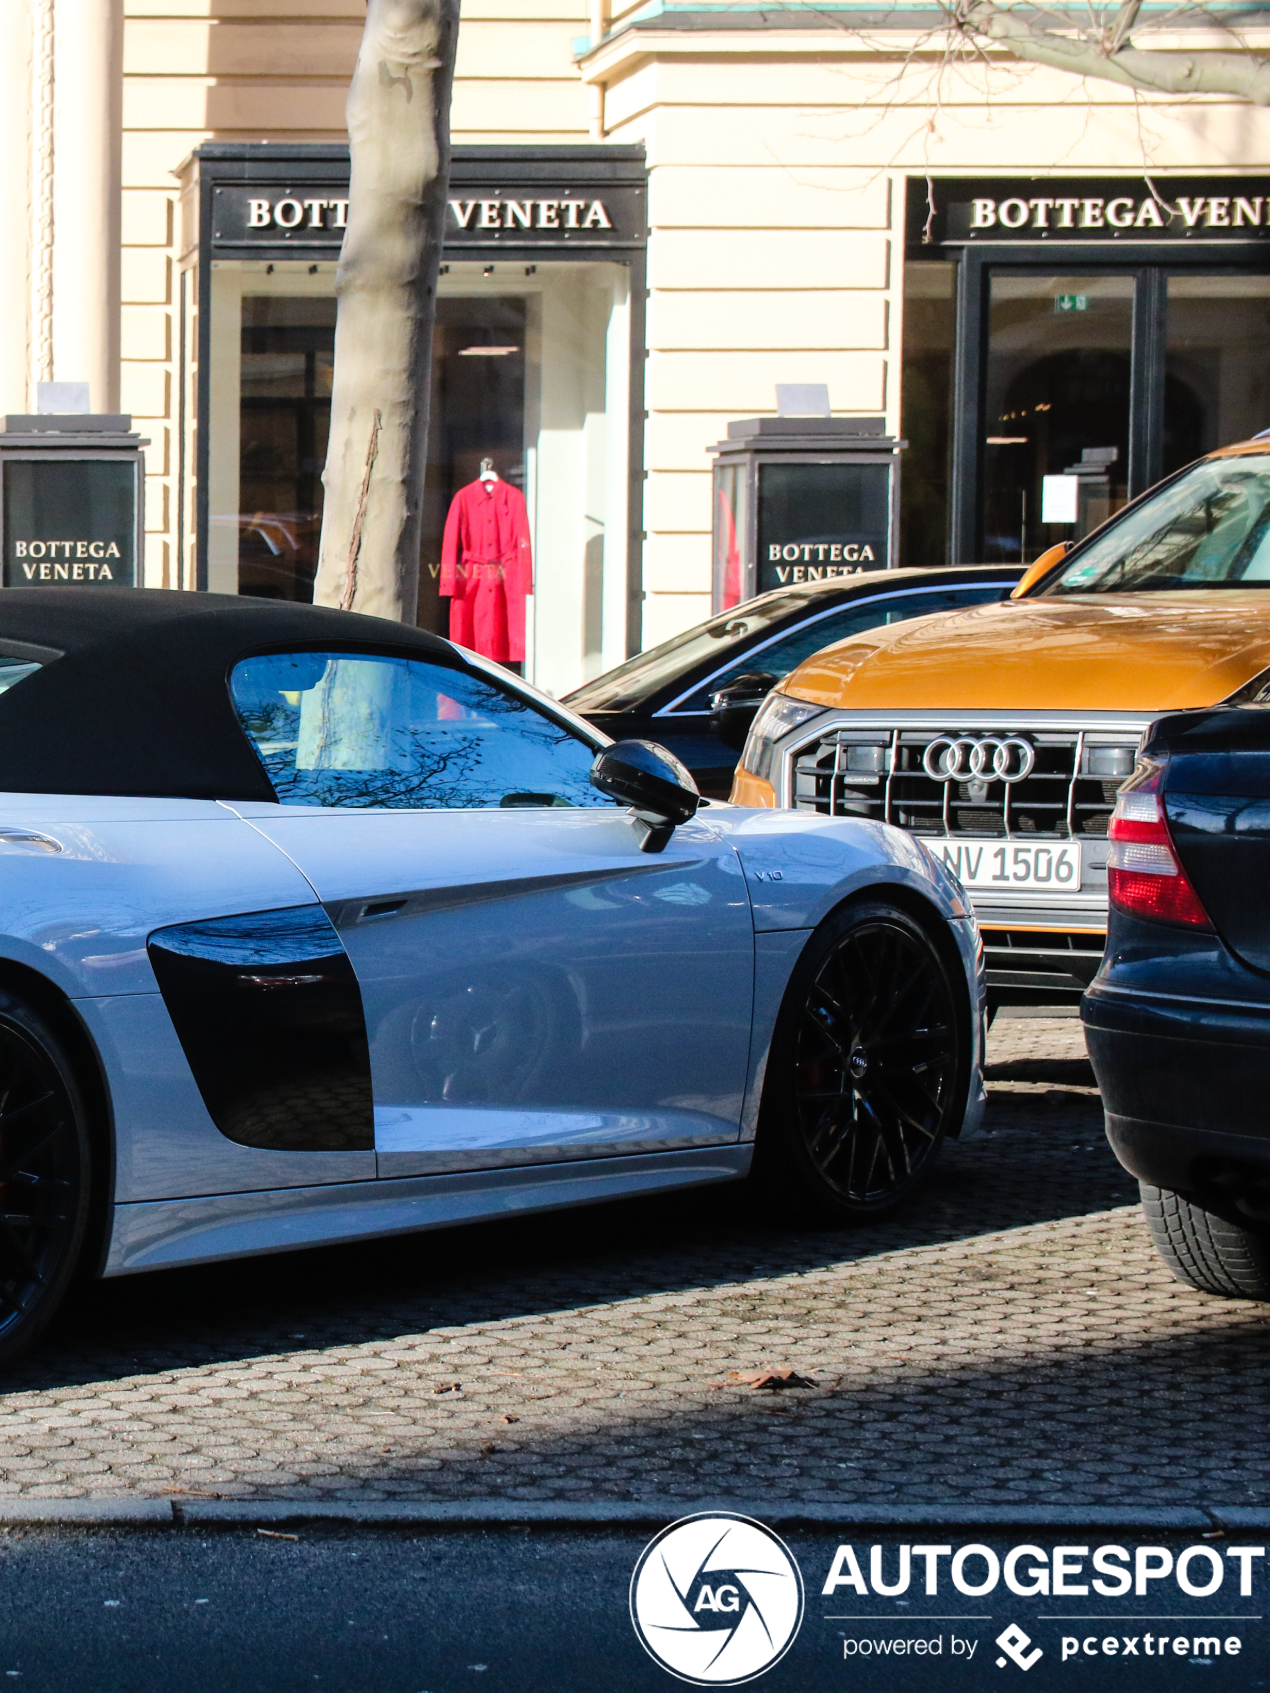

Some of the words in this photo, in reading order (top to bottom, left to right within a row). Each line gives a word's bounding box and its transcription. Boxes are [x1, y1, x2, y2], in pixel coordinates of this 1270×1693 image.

[447, 200, 612, 229] VENETA
[970, 197, 1164, 228] BOTTEGA
[15, 541, 121, 558] BOTTEGA
[769, 543, 875, 561] BOTTEGA
[22, 563, 113, 580] VENETA
[428, 563, 506, 579] VENETA
[943, 846, 983, 880] NV
[992, 847, 1074, 883] 1506
